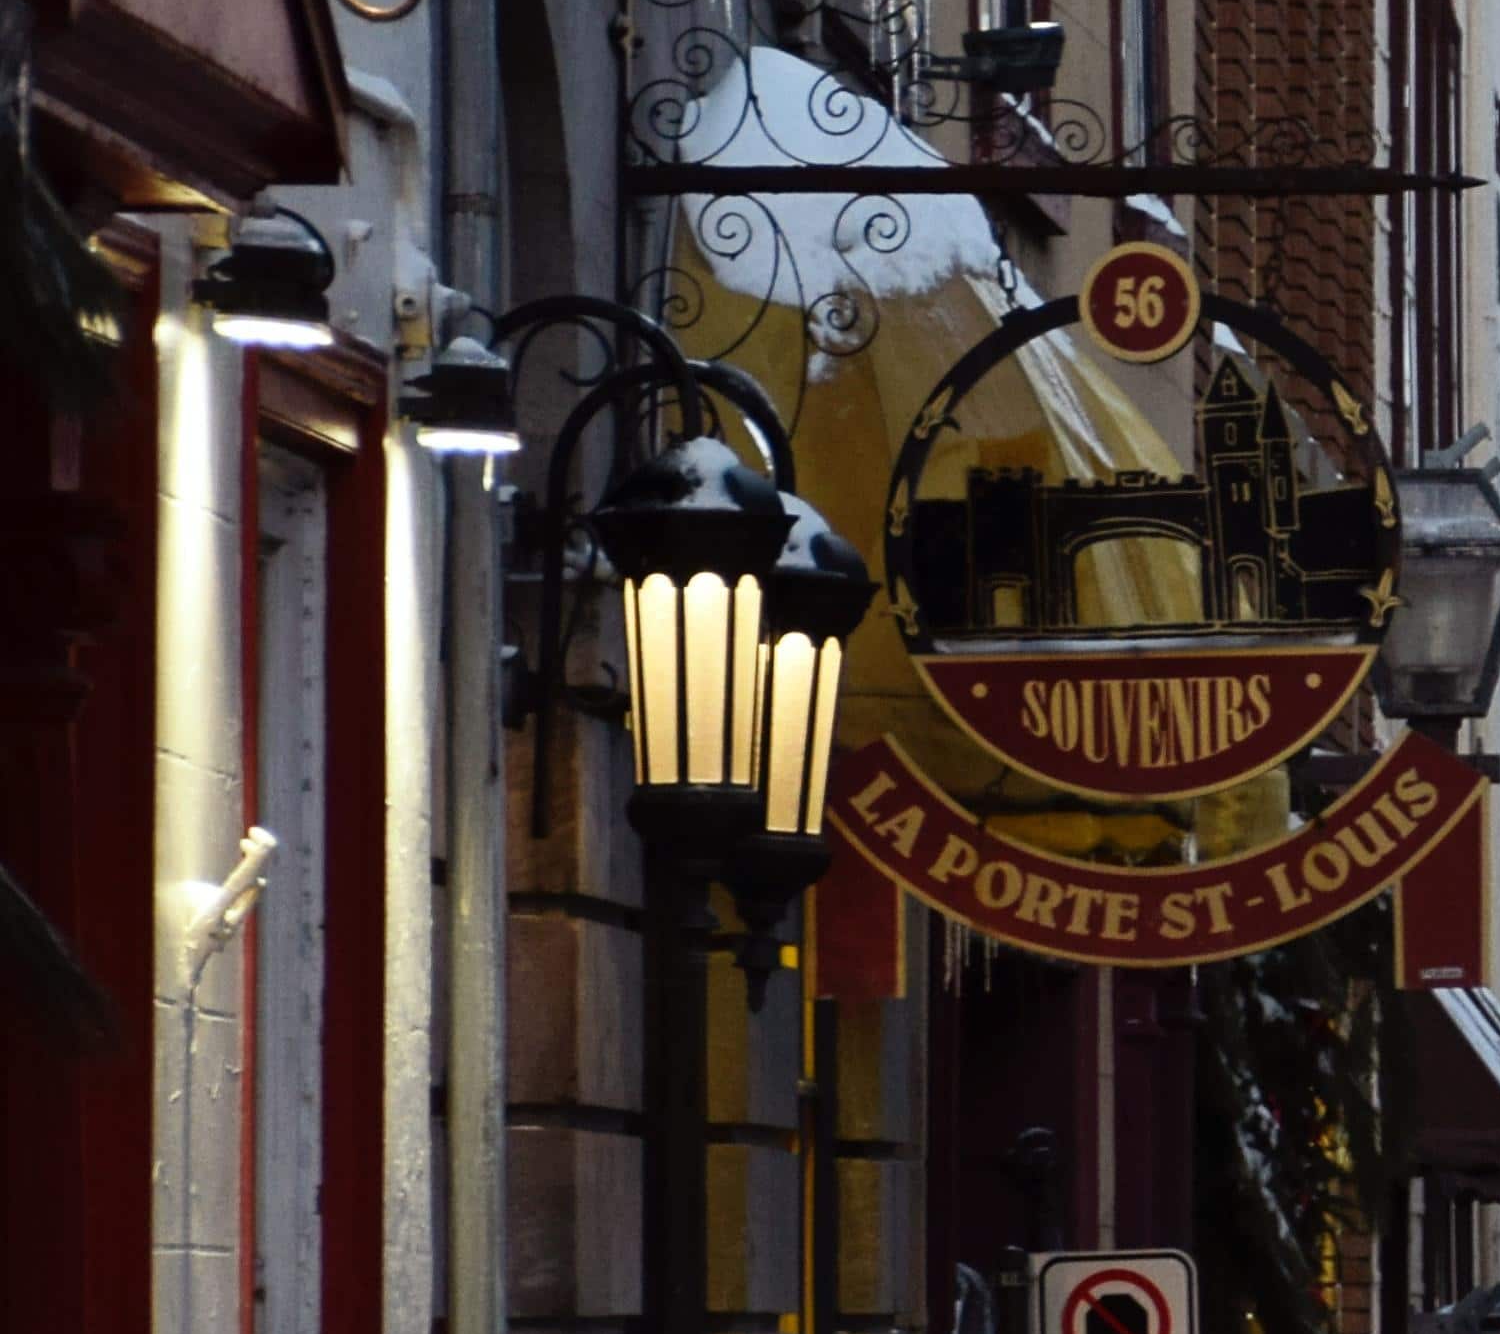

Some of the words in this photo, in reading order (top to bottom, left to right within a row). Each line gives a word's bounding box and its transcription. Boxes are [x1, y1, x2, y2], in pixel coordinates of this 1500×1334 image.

[1114, 275, 1165, 328] 56
[1022, 674, 1272, 767] SOUVENIRS
[847, 771, 921, 858] LA
[928, 834, 1140, 942] PORTE
